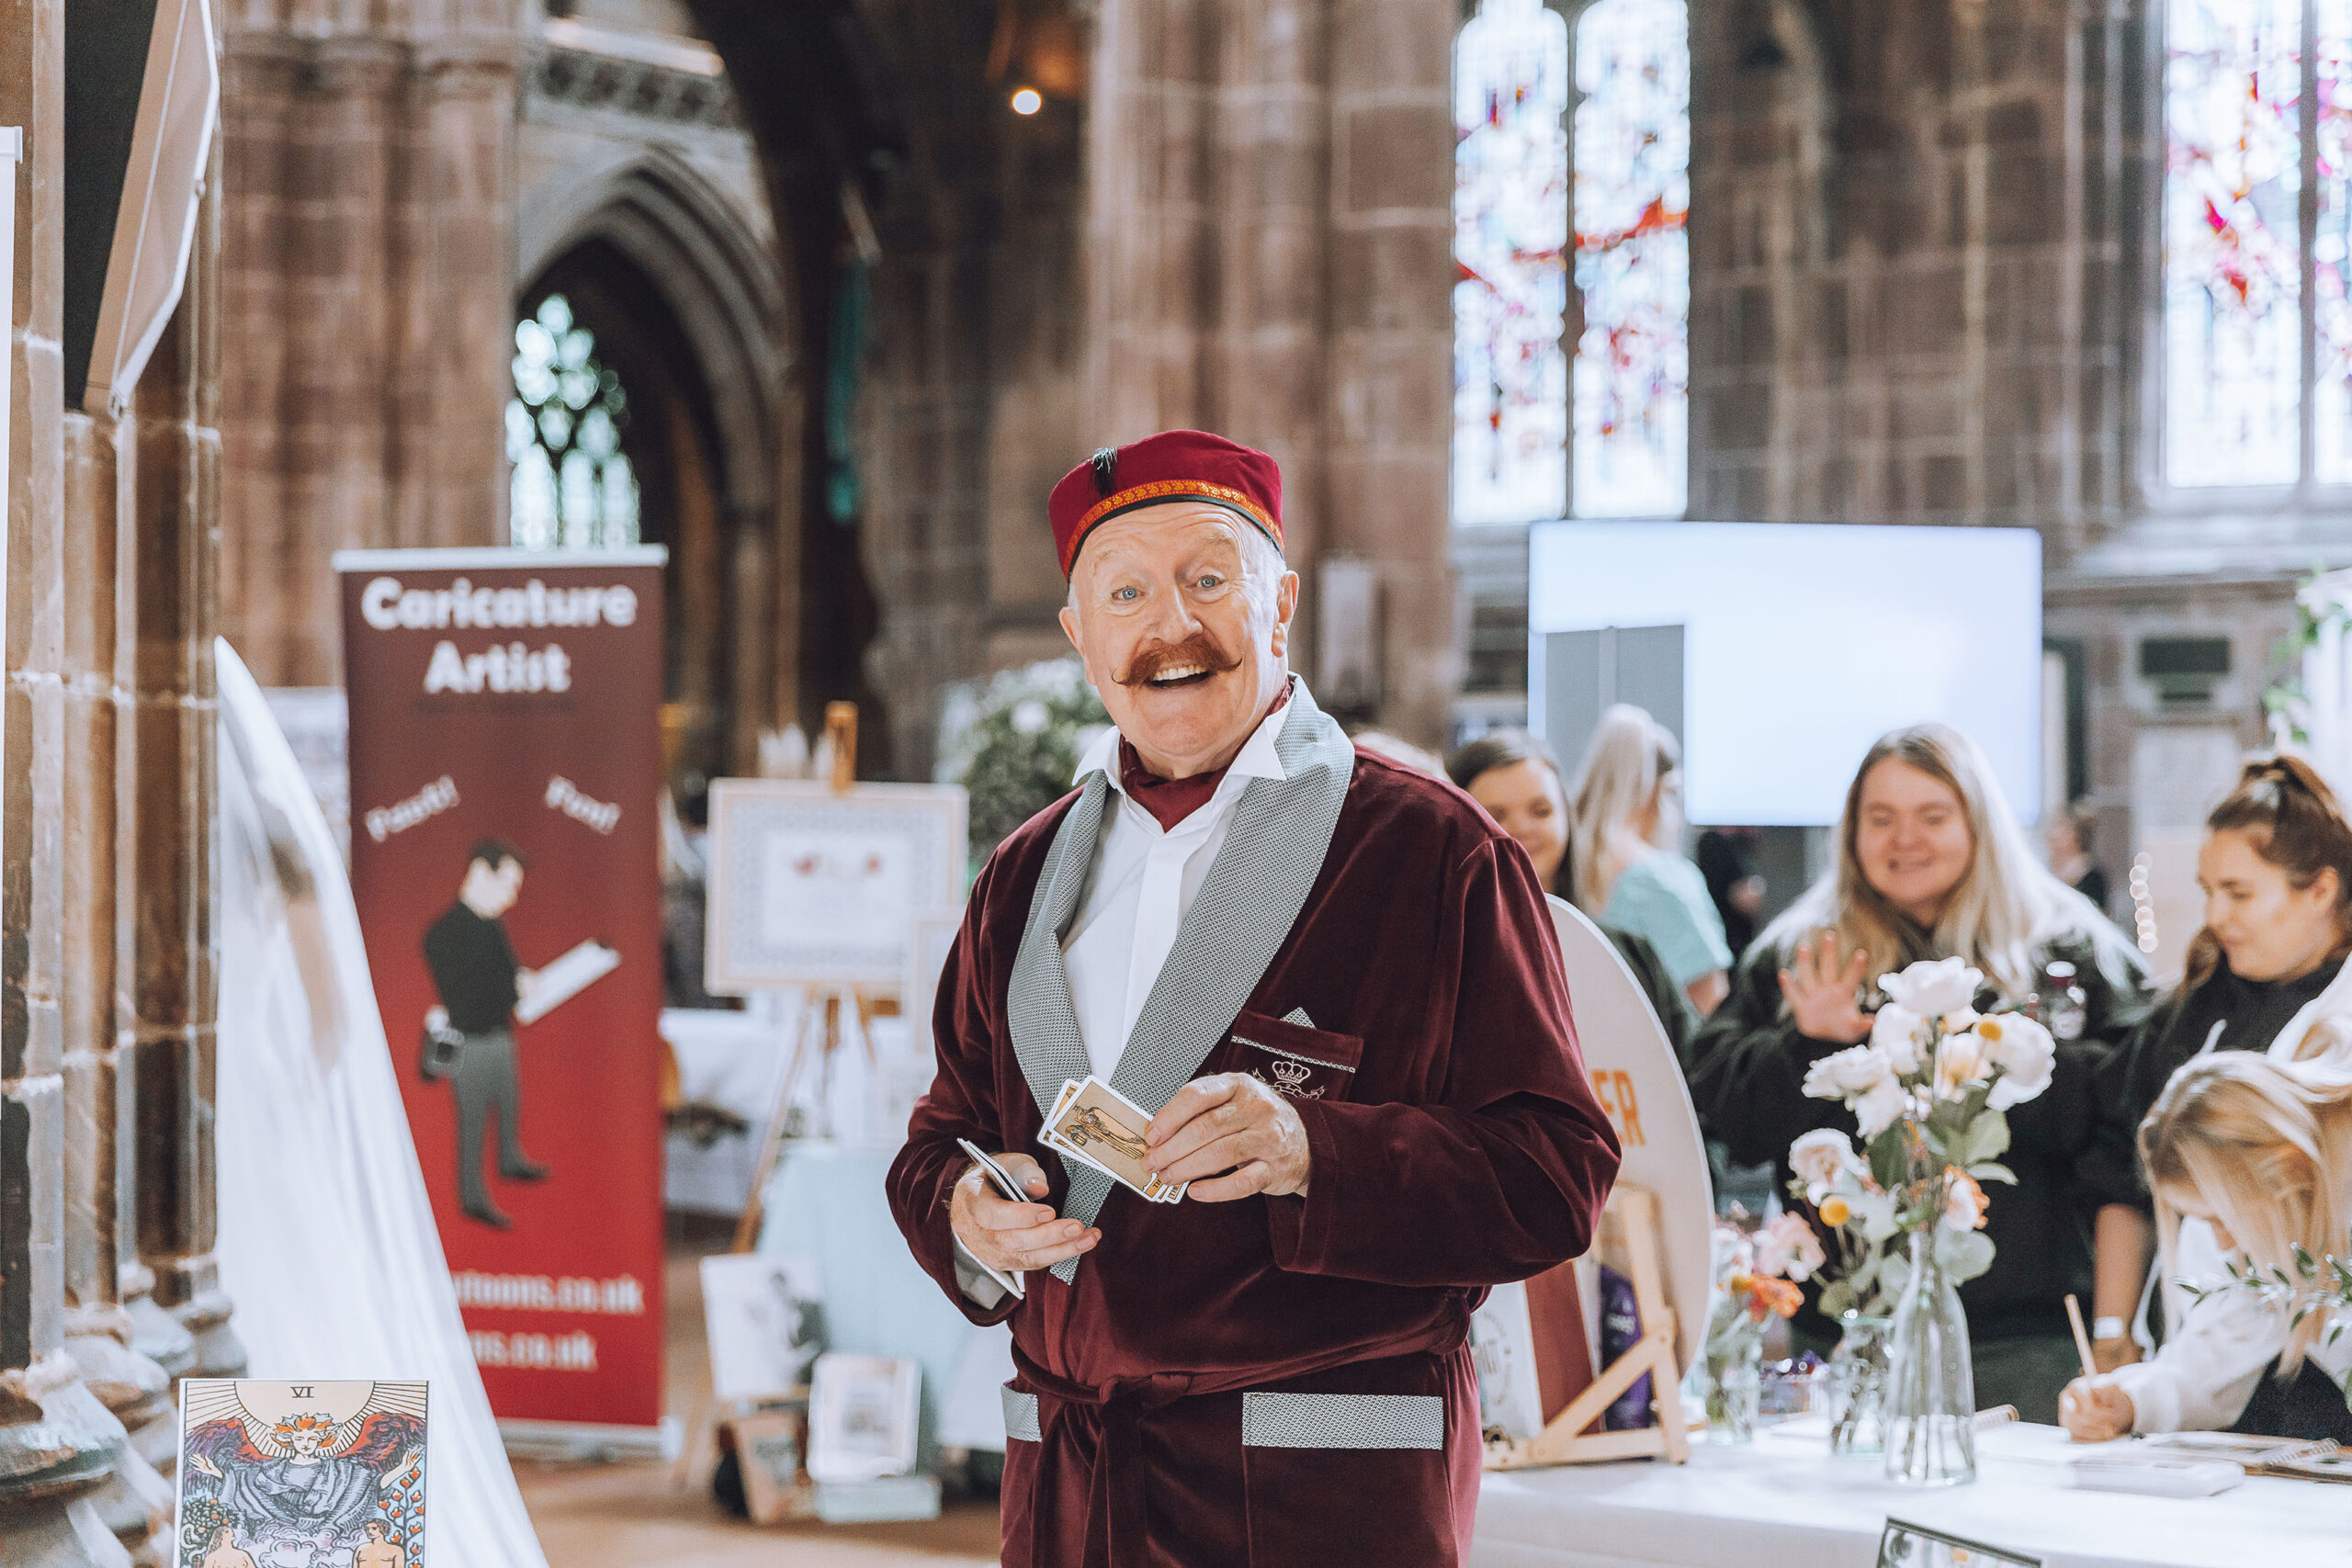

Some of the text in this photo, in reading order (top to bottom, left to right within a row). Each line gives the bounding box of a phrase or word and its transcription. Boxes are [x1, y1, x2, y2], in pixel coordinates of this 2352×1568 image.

[362, 577, 638, 630] Caricature
[424, 640, 571, 694] Artist
[290, 1386, 315, 1398] VI
